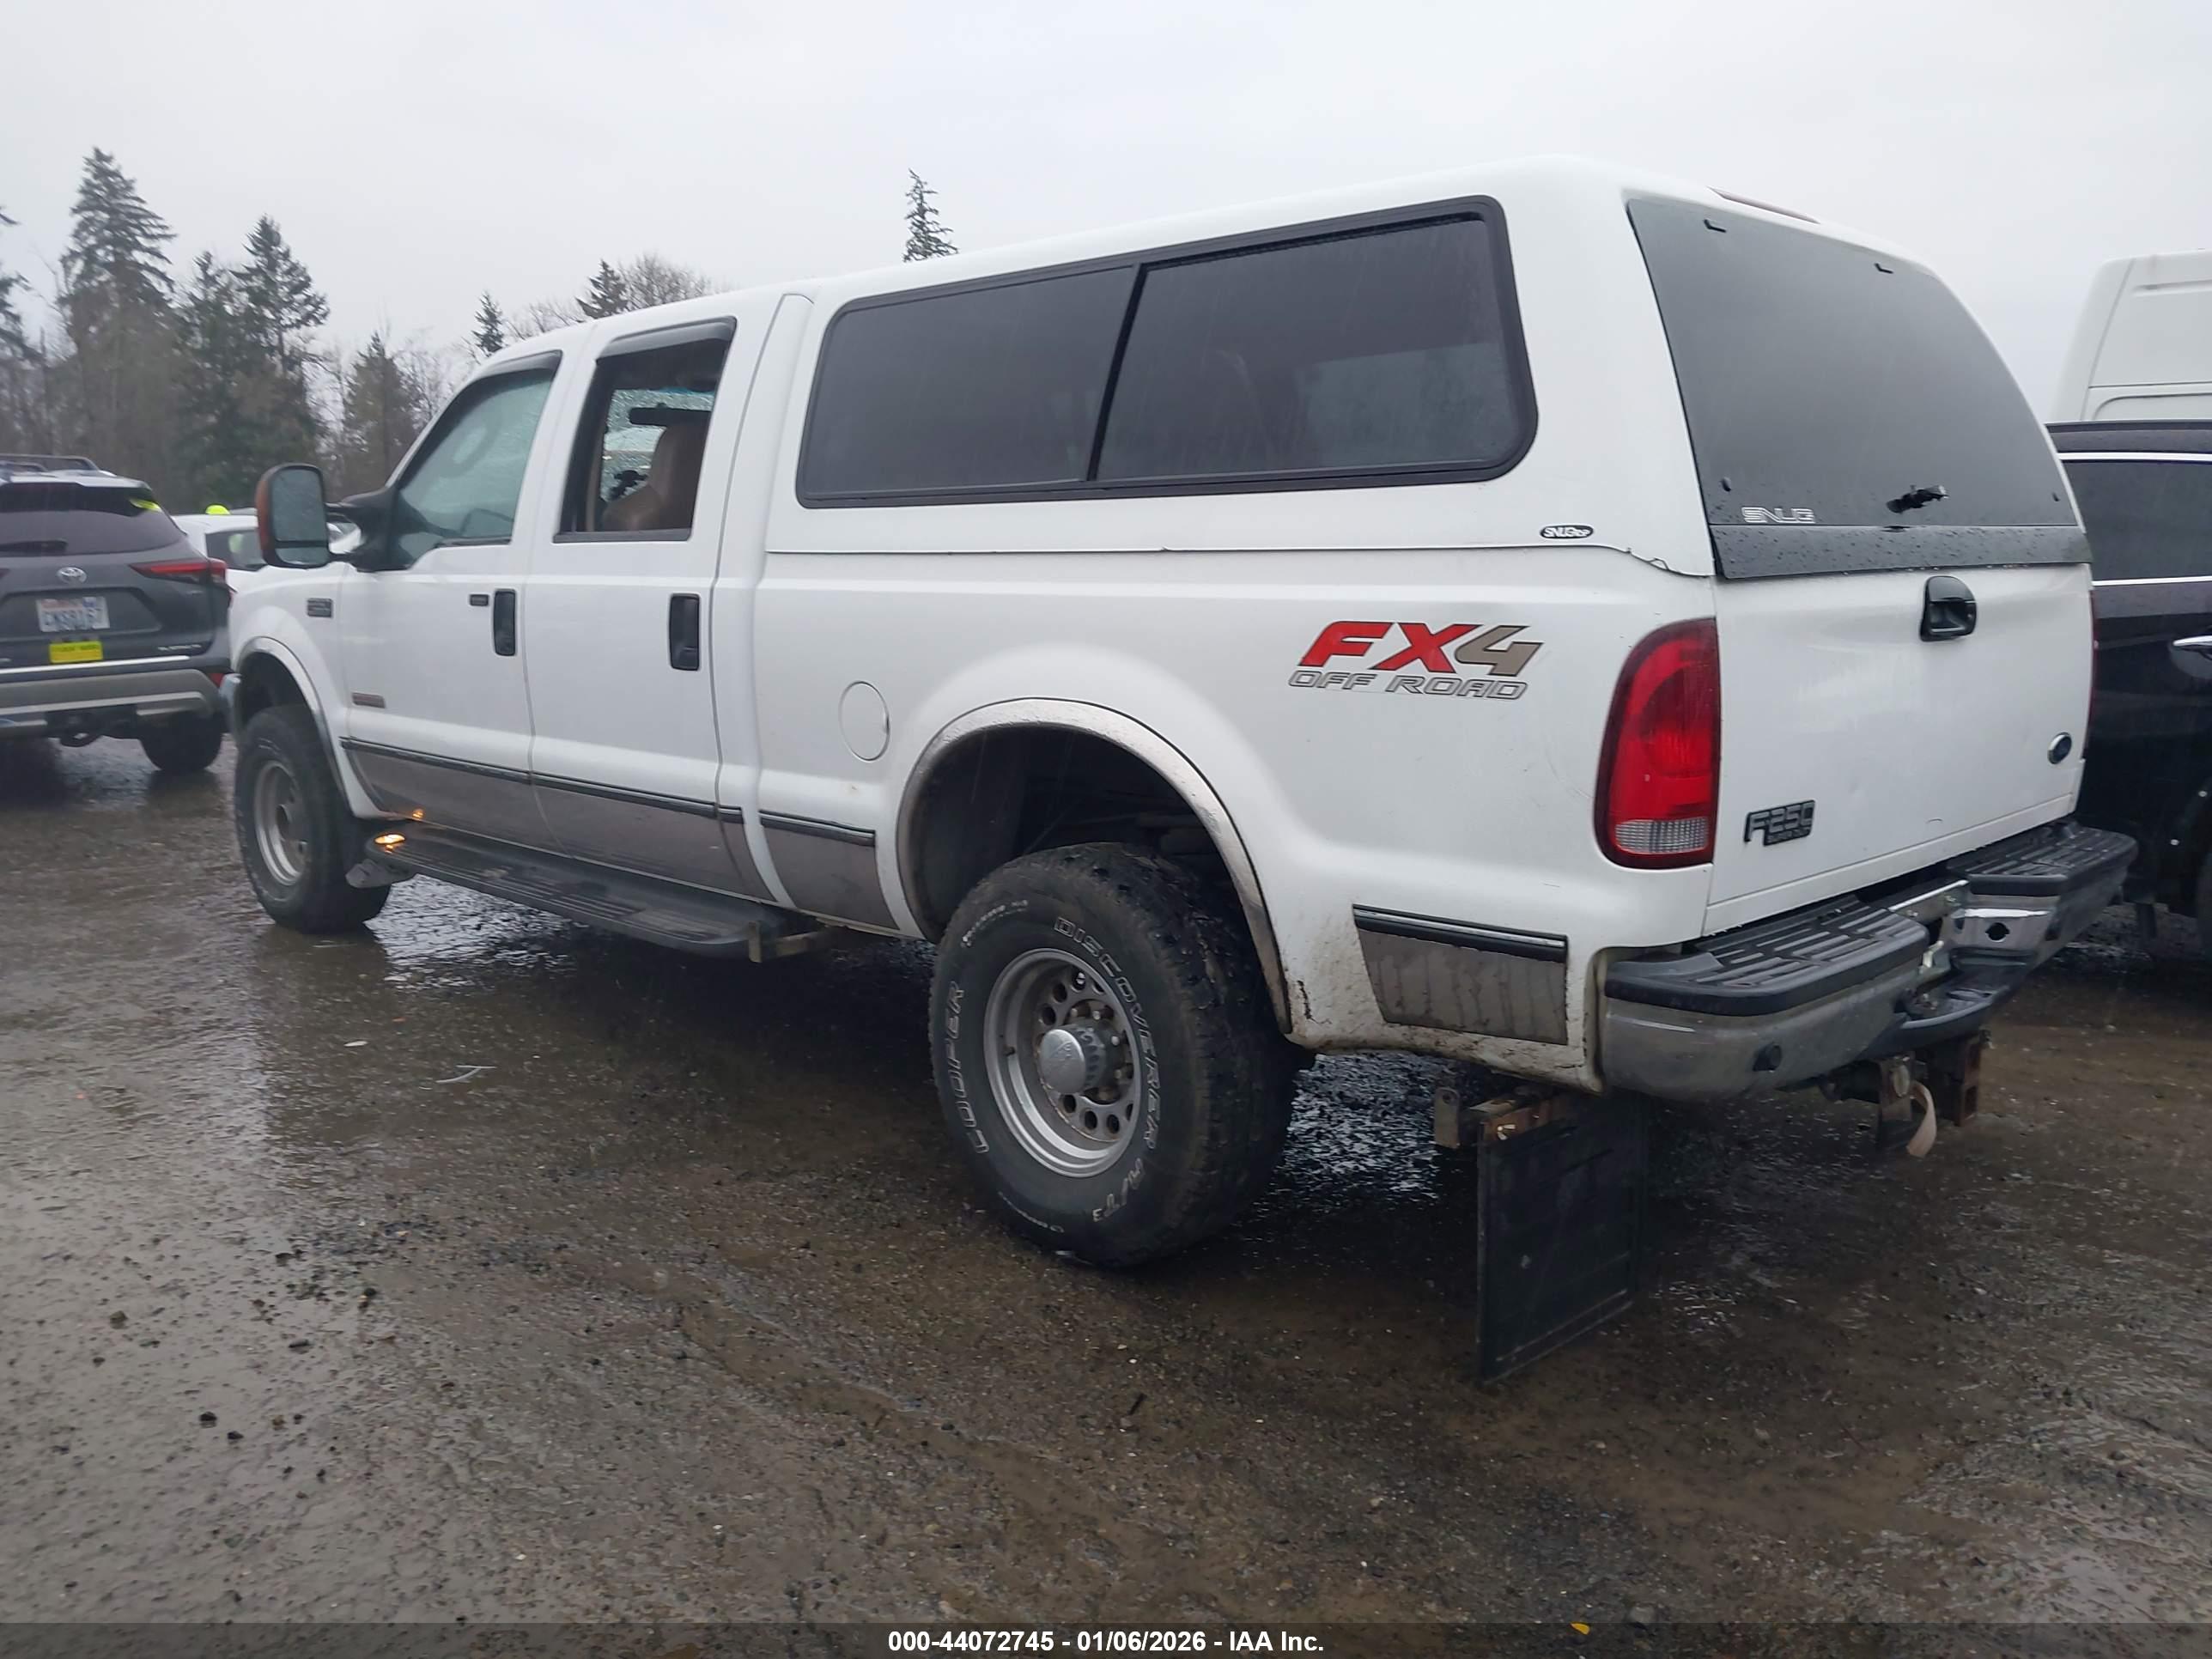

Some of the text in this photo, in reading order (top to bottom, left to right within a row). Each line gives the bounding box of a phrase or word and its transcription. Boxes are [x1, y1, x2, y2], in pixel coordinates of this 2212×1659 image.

[1297, 621, 1545, 677] FX4
[1288, 670, 1528, 700] OFF ROAD
[945, 981, 989, 1154] COOPER
